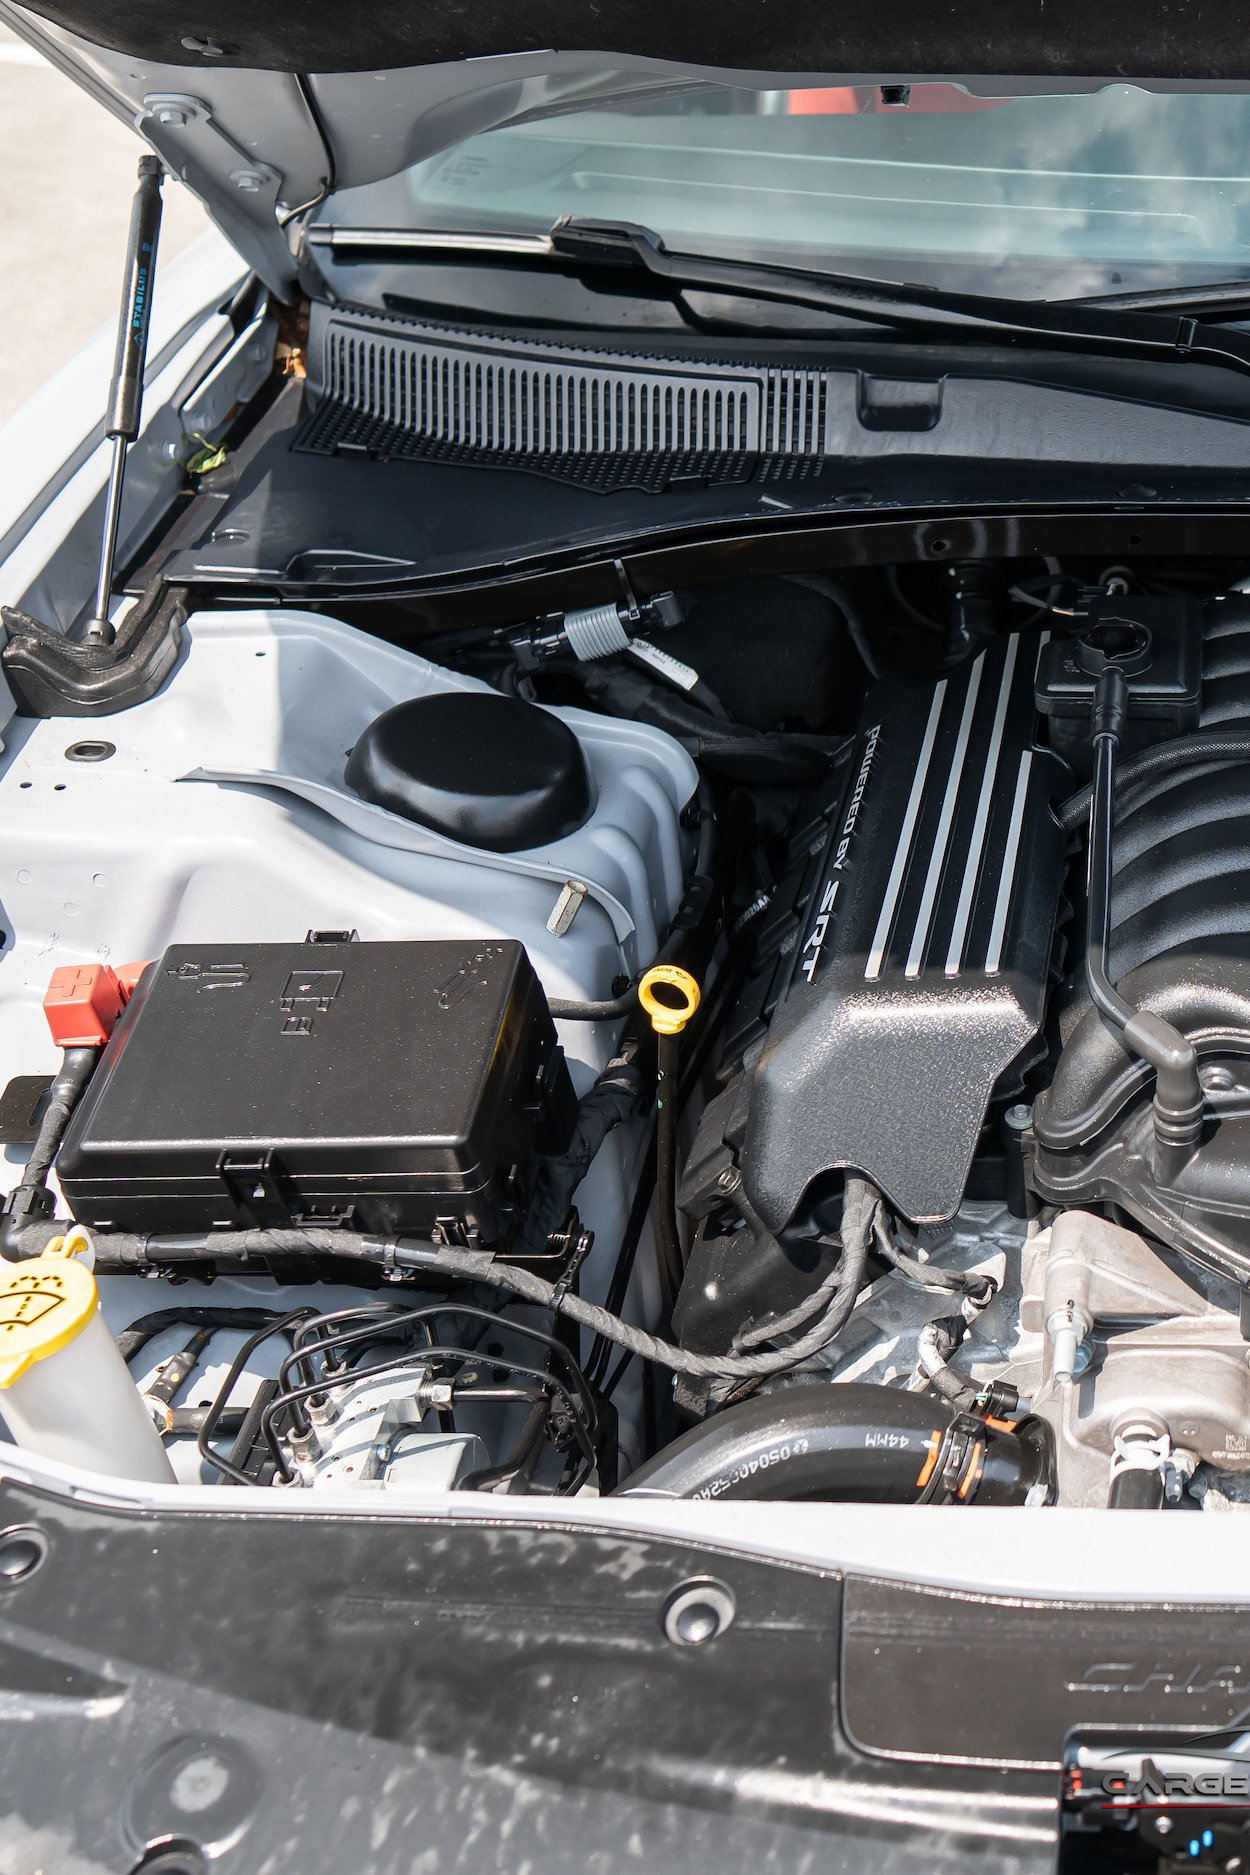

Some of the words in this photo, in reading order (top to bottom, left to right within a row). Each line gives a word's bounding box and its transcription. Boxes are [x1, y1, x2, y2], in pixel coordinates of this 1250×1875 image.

[843, 724, 882, 835] POWERED
[833, 837, 851, 870] BY
[802, 880, 840, 983] SRT
[866, 1433, 909, 1448] 44MM
